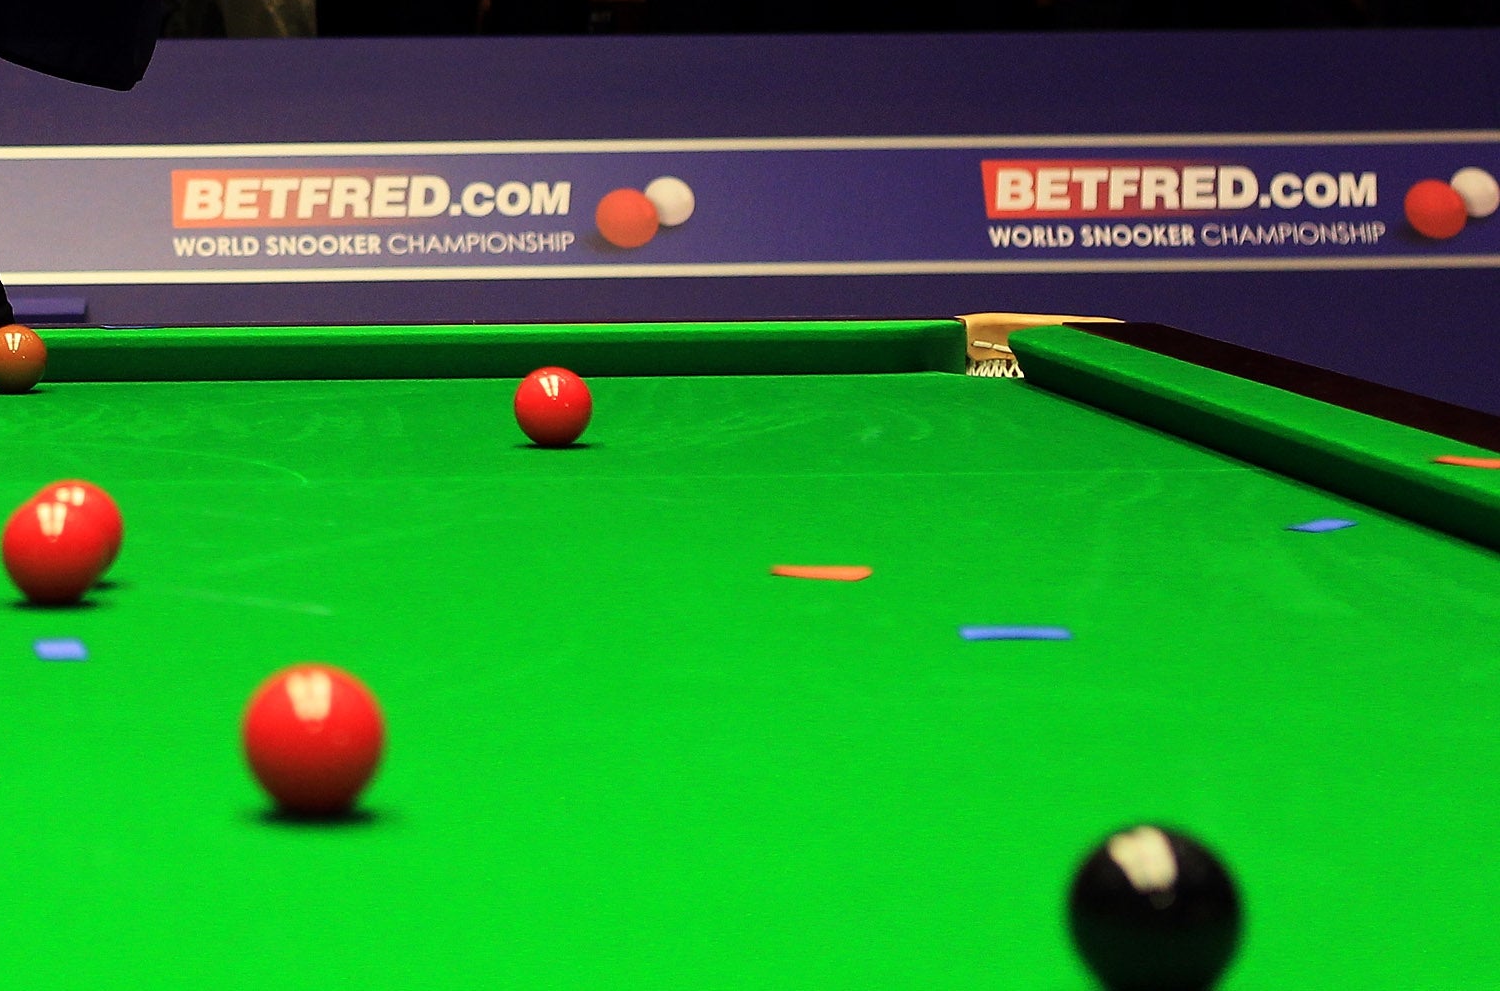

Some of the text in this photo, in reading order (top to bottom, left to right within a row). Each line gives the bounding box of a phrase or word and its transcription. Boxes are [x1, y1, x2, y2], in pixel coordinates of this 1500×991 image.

[181, 175, 572, 220] BETFRED.COM
[994, 165, 1378, 212] BETFRED.COM
[173, 231, 575, 257] WORLD SNOOKER CHAMPIONSHIP
[988, 221, 1386, 248] WORLD SNOOKER CHAMPIONSHIP
